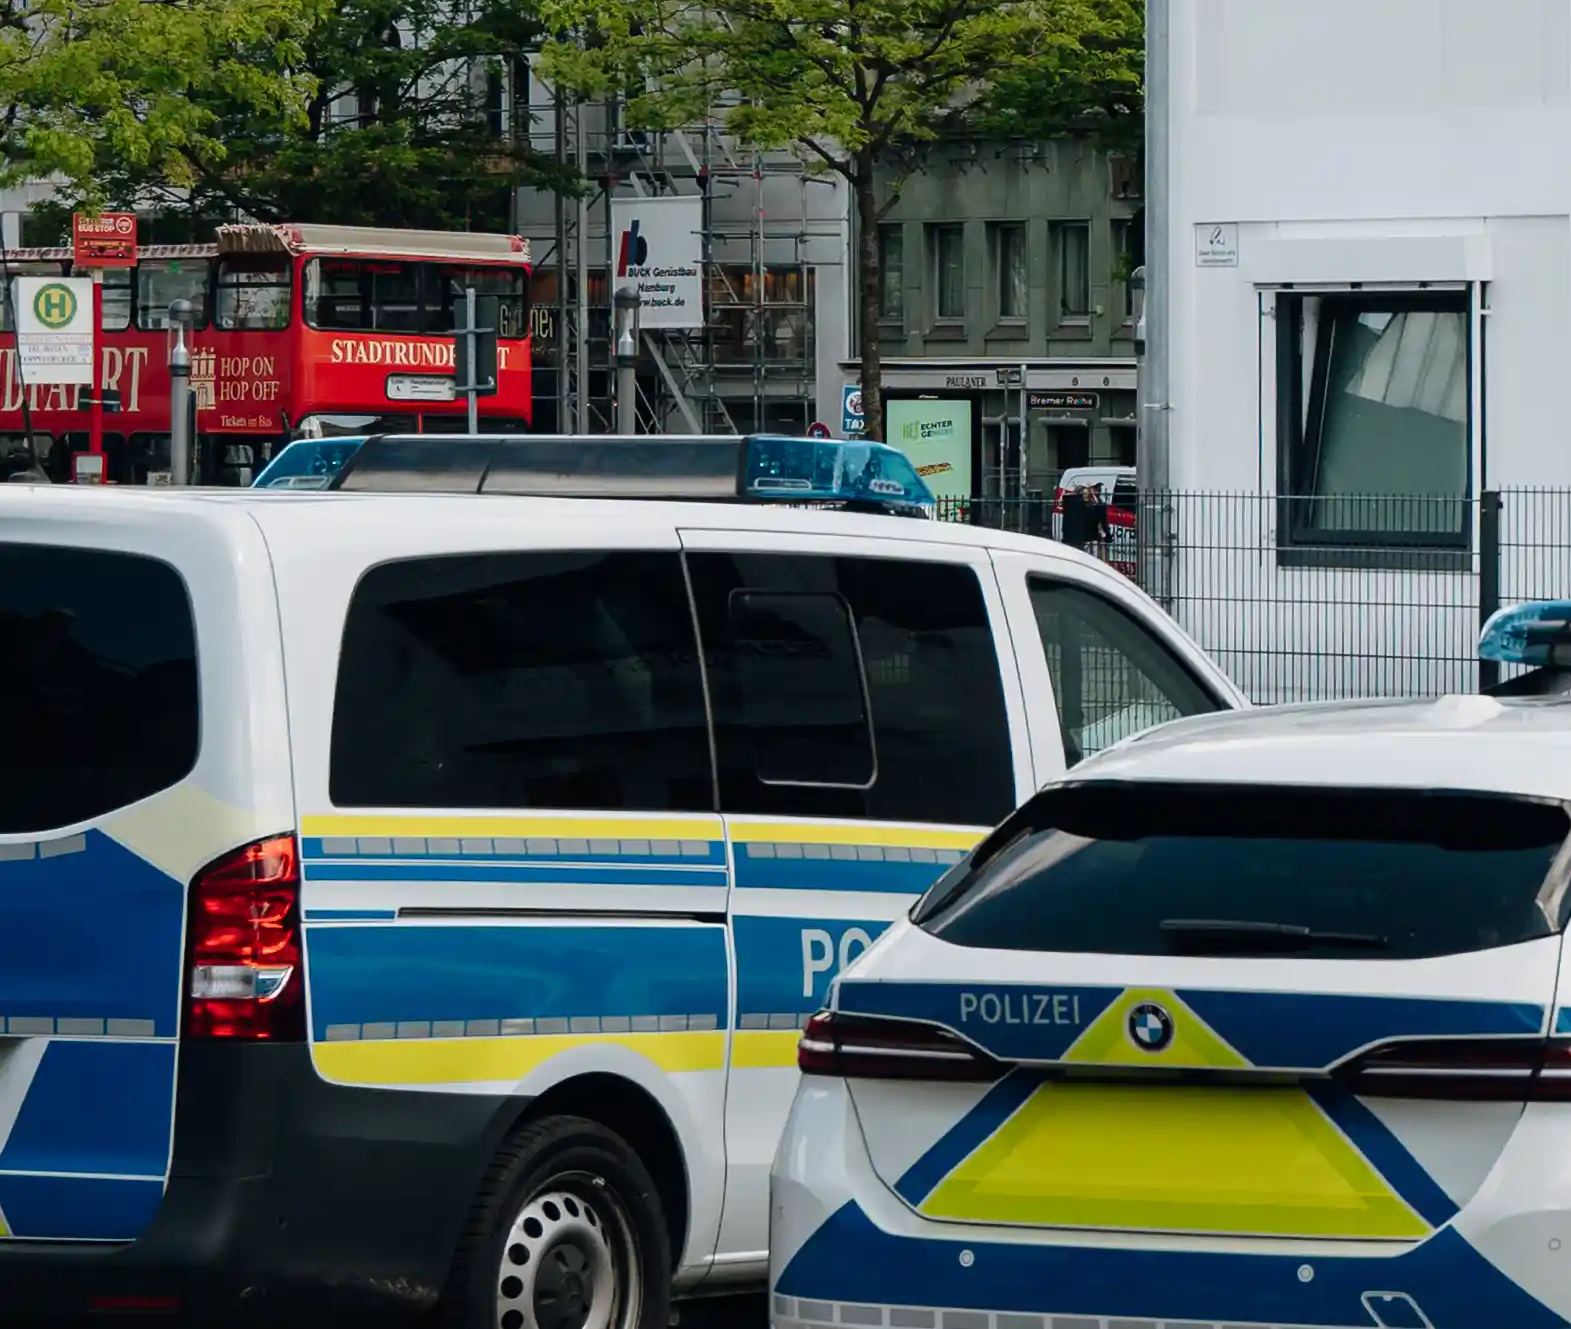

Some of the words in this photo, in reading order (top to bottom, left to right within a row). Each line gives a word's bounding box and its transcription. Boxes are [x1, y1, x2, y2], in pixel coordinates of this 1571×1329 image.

[627, 267, 651, 277] BUCK
[331, 338, 510, 370] STADTRUNDFT
[220, 356, 250, 377] HOP
[252, 356, 275, 376] ON
[945, 376, 987, 388] PAULANER
[220, 381, 250, 401] HOP
[252, 380, 280, 401] OFF
[1030, 395, 1065, 405] Bremer
[920, 419, 953, 431] ECHTER
[960, 992, 1080, 1025] POLIZEI
